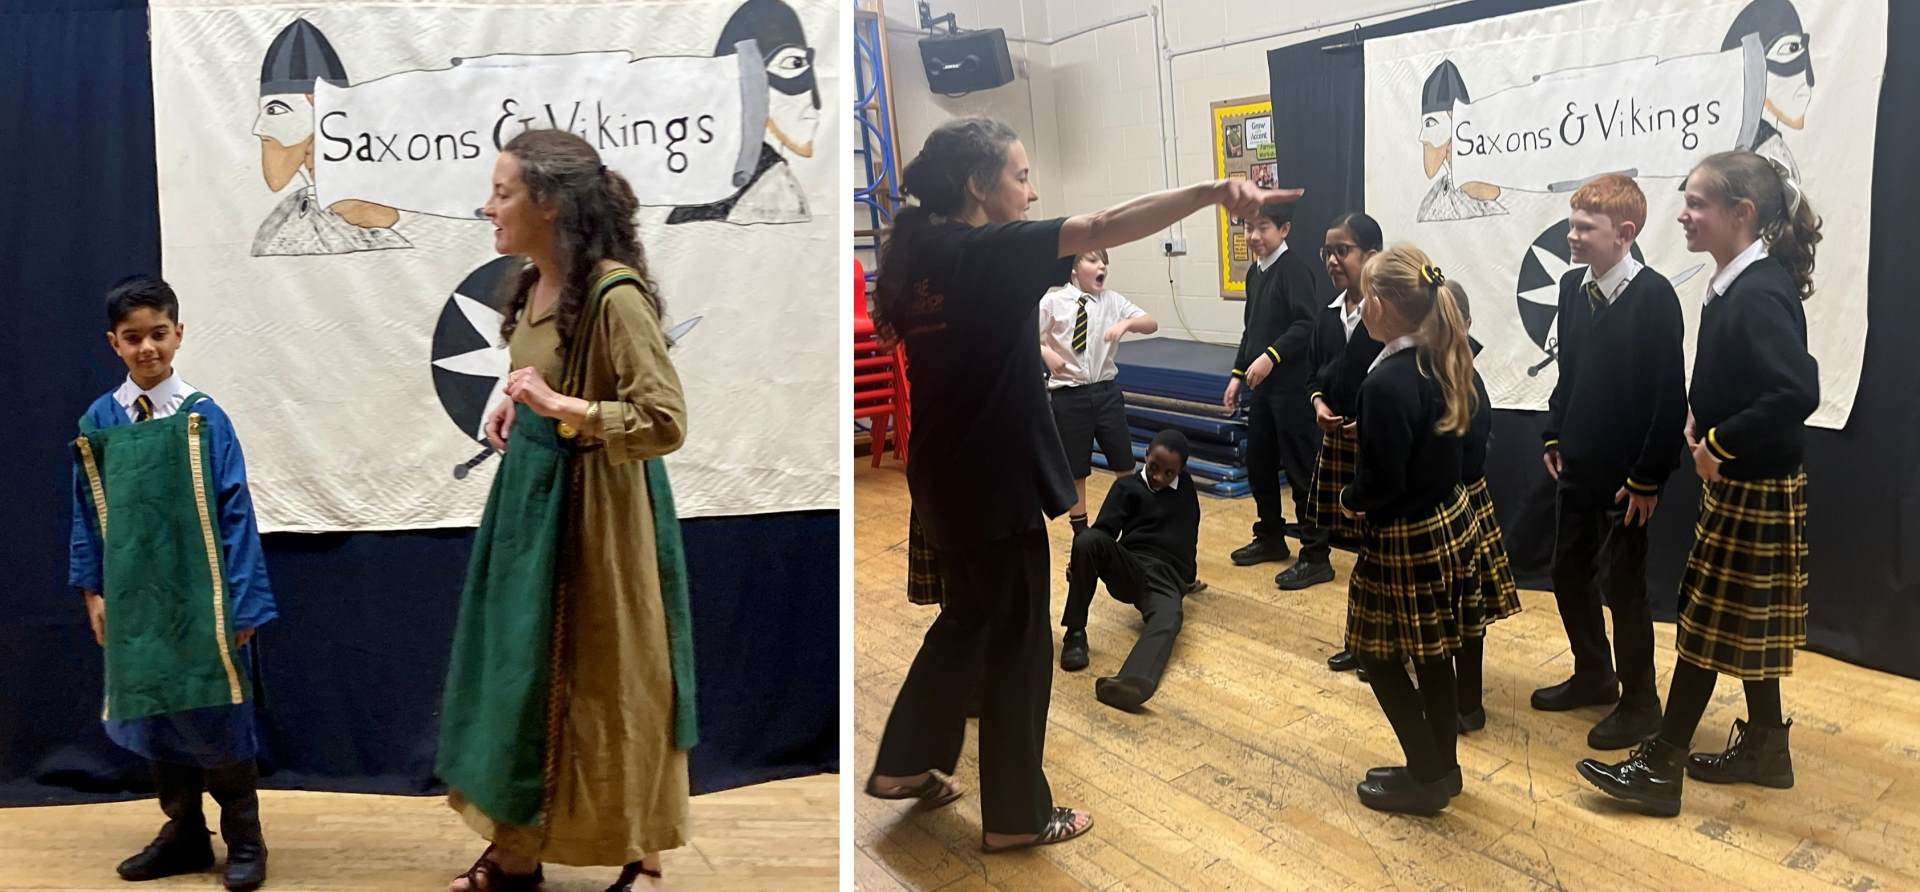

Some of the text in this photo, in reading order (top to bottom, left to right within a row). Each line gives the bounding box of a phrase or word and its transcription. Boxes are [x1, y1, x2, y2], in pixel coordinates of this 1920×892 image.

[320, 111, 481, 162] Saxons
[1455, 97, 1721, 156] Saxons & Vikings
